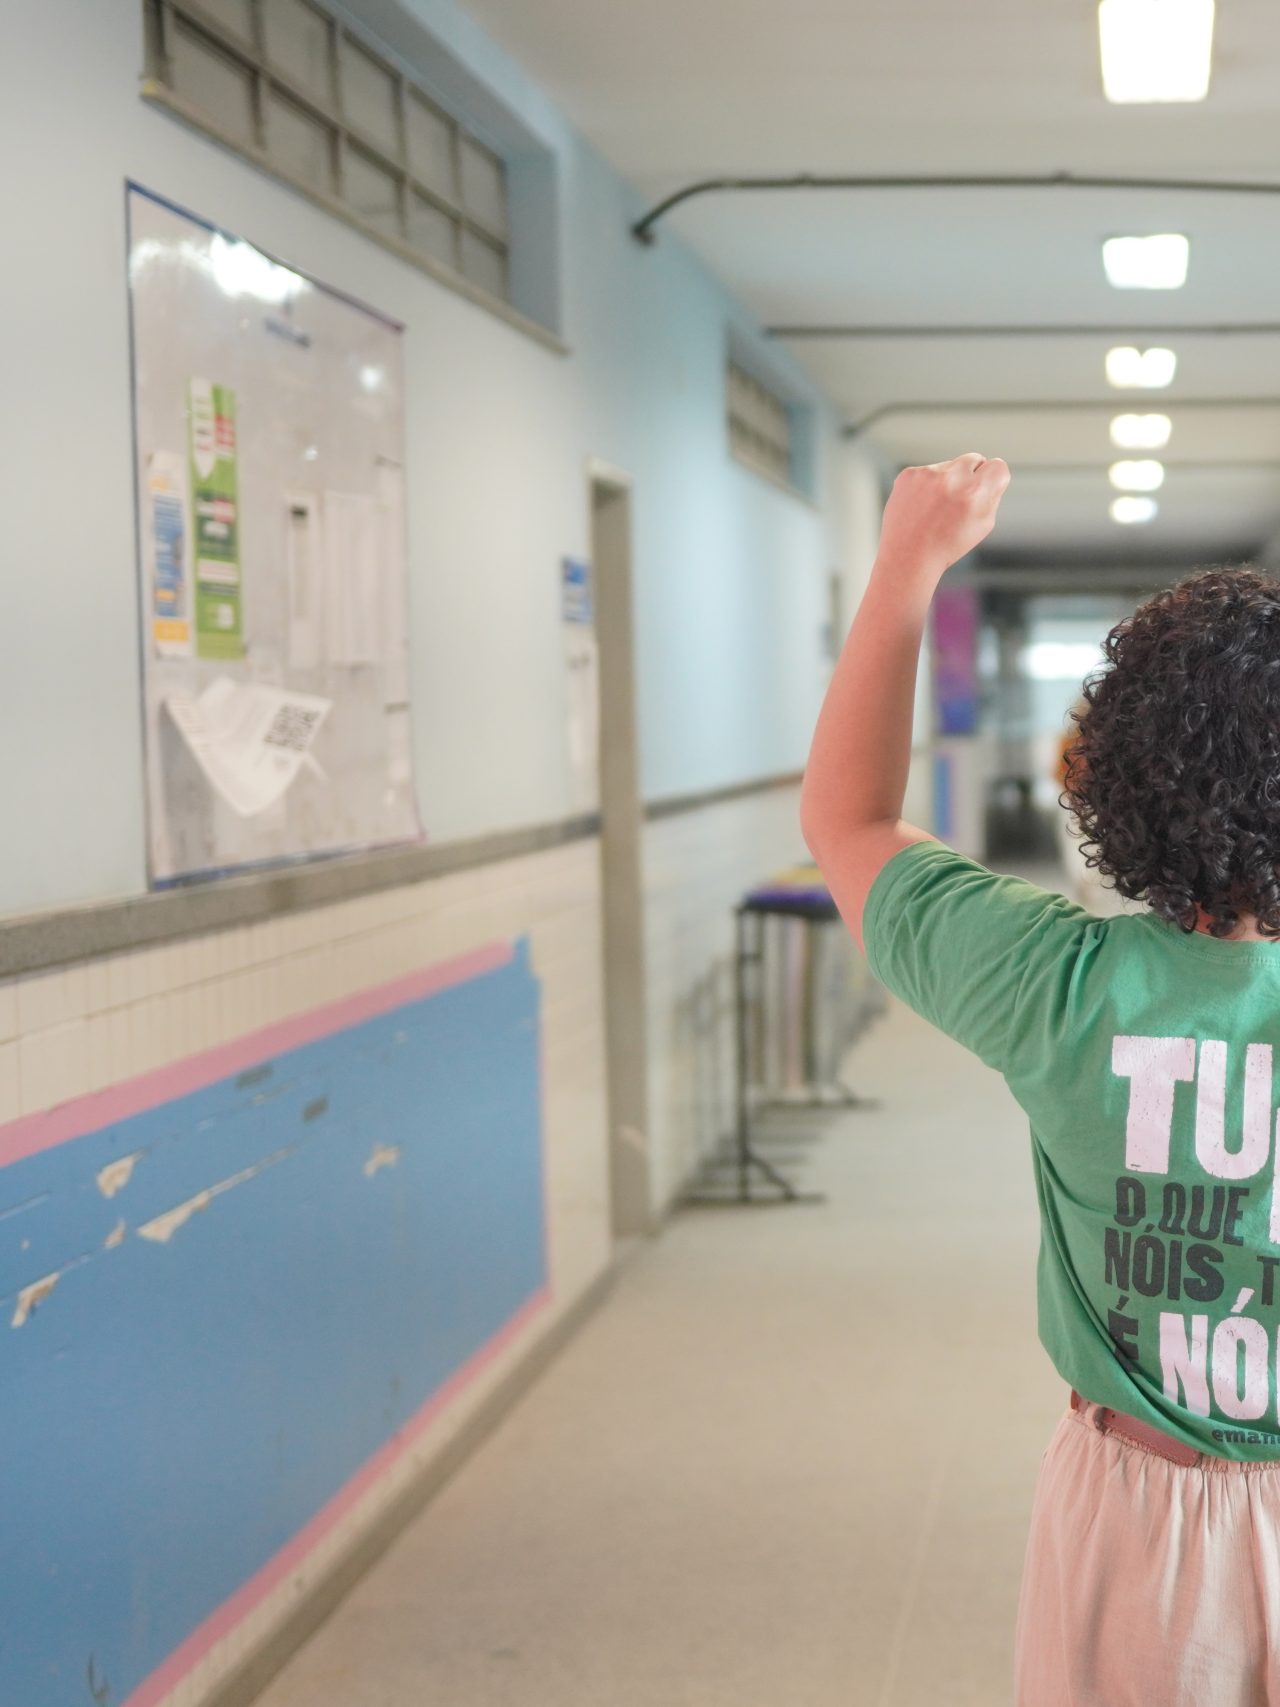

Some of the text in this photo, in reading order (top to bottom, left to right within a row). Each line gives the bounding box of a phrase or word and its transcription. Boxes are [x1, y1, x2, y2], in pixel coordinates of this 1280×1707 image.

[1113, 1176, 1250, 1246] O QUE
[1104, 1223, 1225, 1302] NÓIS
[1107, 1294, 1140, 1374] É
